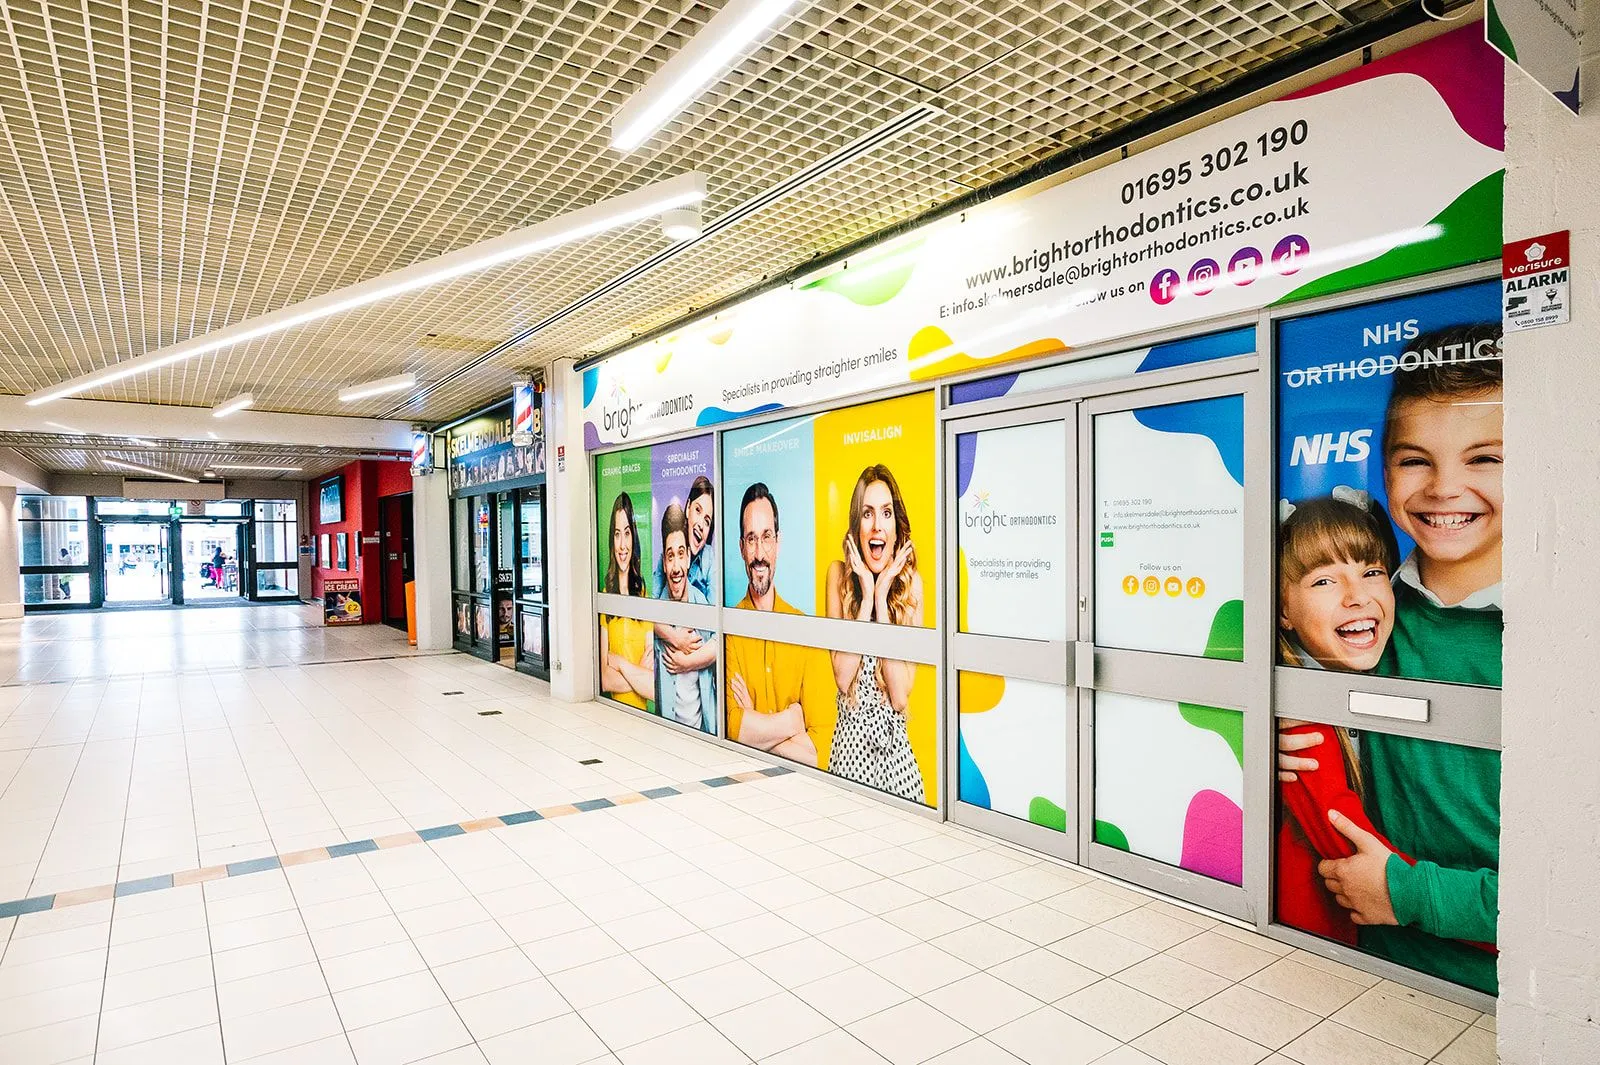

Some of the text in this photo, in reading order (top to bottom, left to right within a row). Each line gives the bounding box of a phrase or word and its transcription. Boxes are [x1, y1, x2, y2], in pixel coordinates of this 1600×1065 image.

[1121, 119, 1308, 205] 01695 302 190
[965, 161, 1310, 290] www.brightorthodontics.co.uk
[1509, 257, 1563, 274] verisure
[1110, 286, 1125, 298] us
[1128, 281, 1145, 293] on
[1505, 269, 1568, 294] ALARM
[939, 305, 950, 319] E:
[1363, 318, 1420, 347] NHS
[722, 346, 897, 404] Specialists in providing straighter smiles
[843, 425, 903, 446] INVISALIGN
[755, 438, 800, 454] MAKEOVER
[1289, 429, 1373, 467] NHS
[666, 450, 700, 464] SPECIALIST
[621, 463, 641, 475] BRACES
[661, 463, 707, 478] ORTHODONTICS
[965, 510, 1057, 534] bright ORTHODONTICS
[969, 557, 1051, 571] Specialists in providing
[1139, 563, 1161, 571] Follow
[980, 569, 1039, 581] straighter smiles
